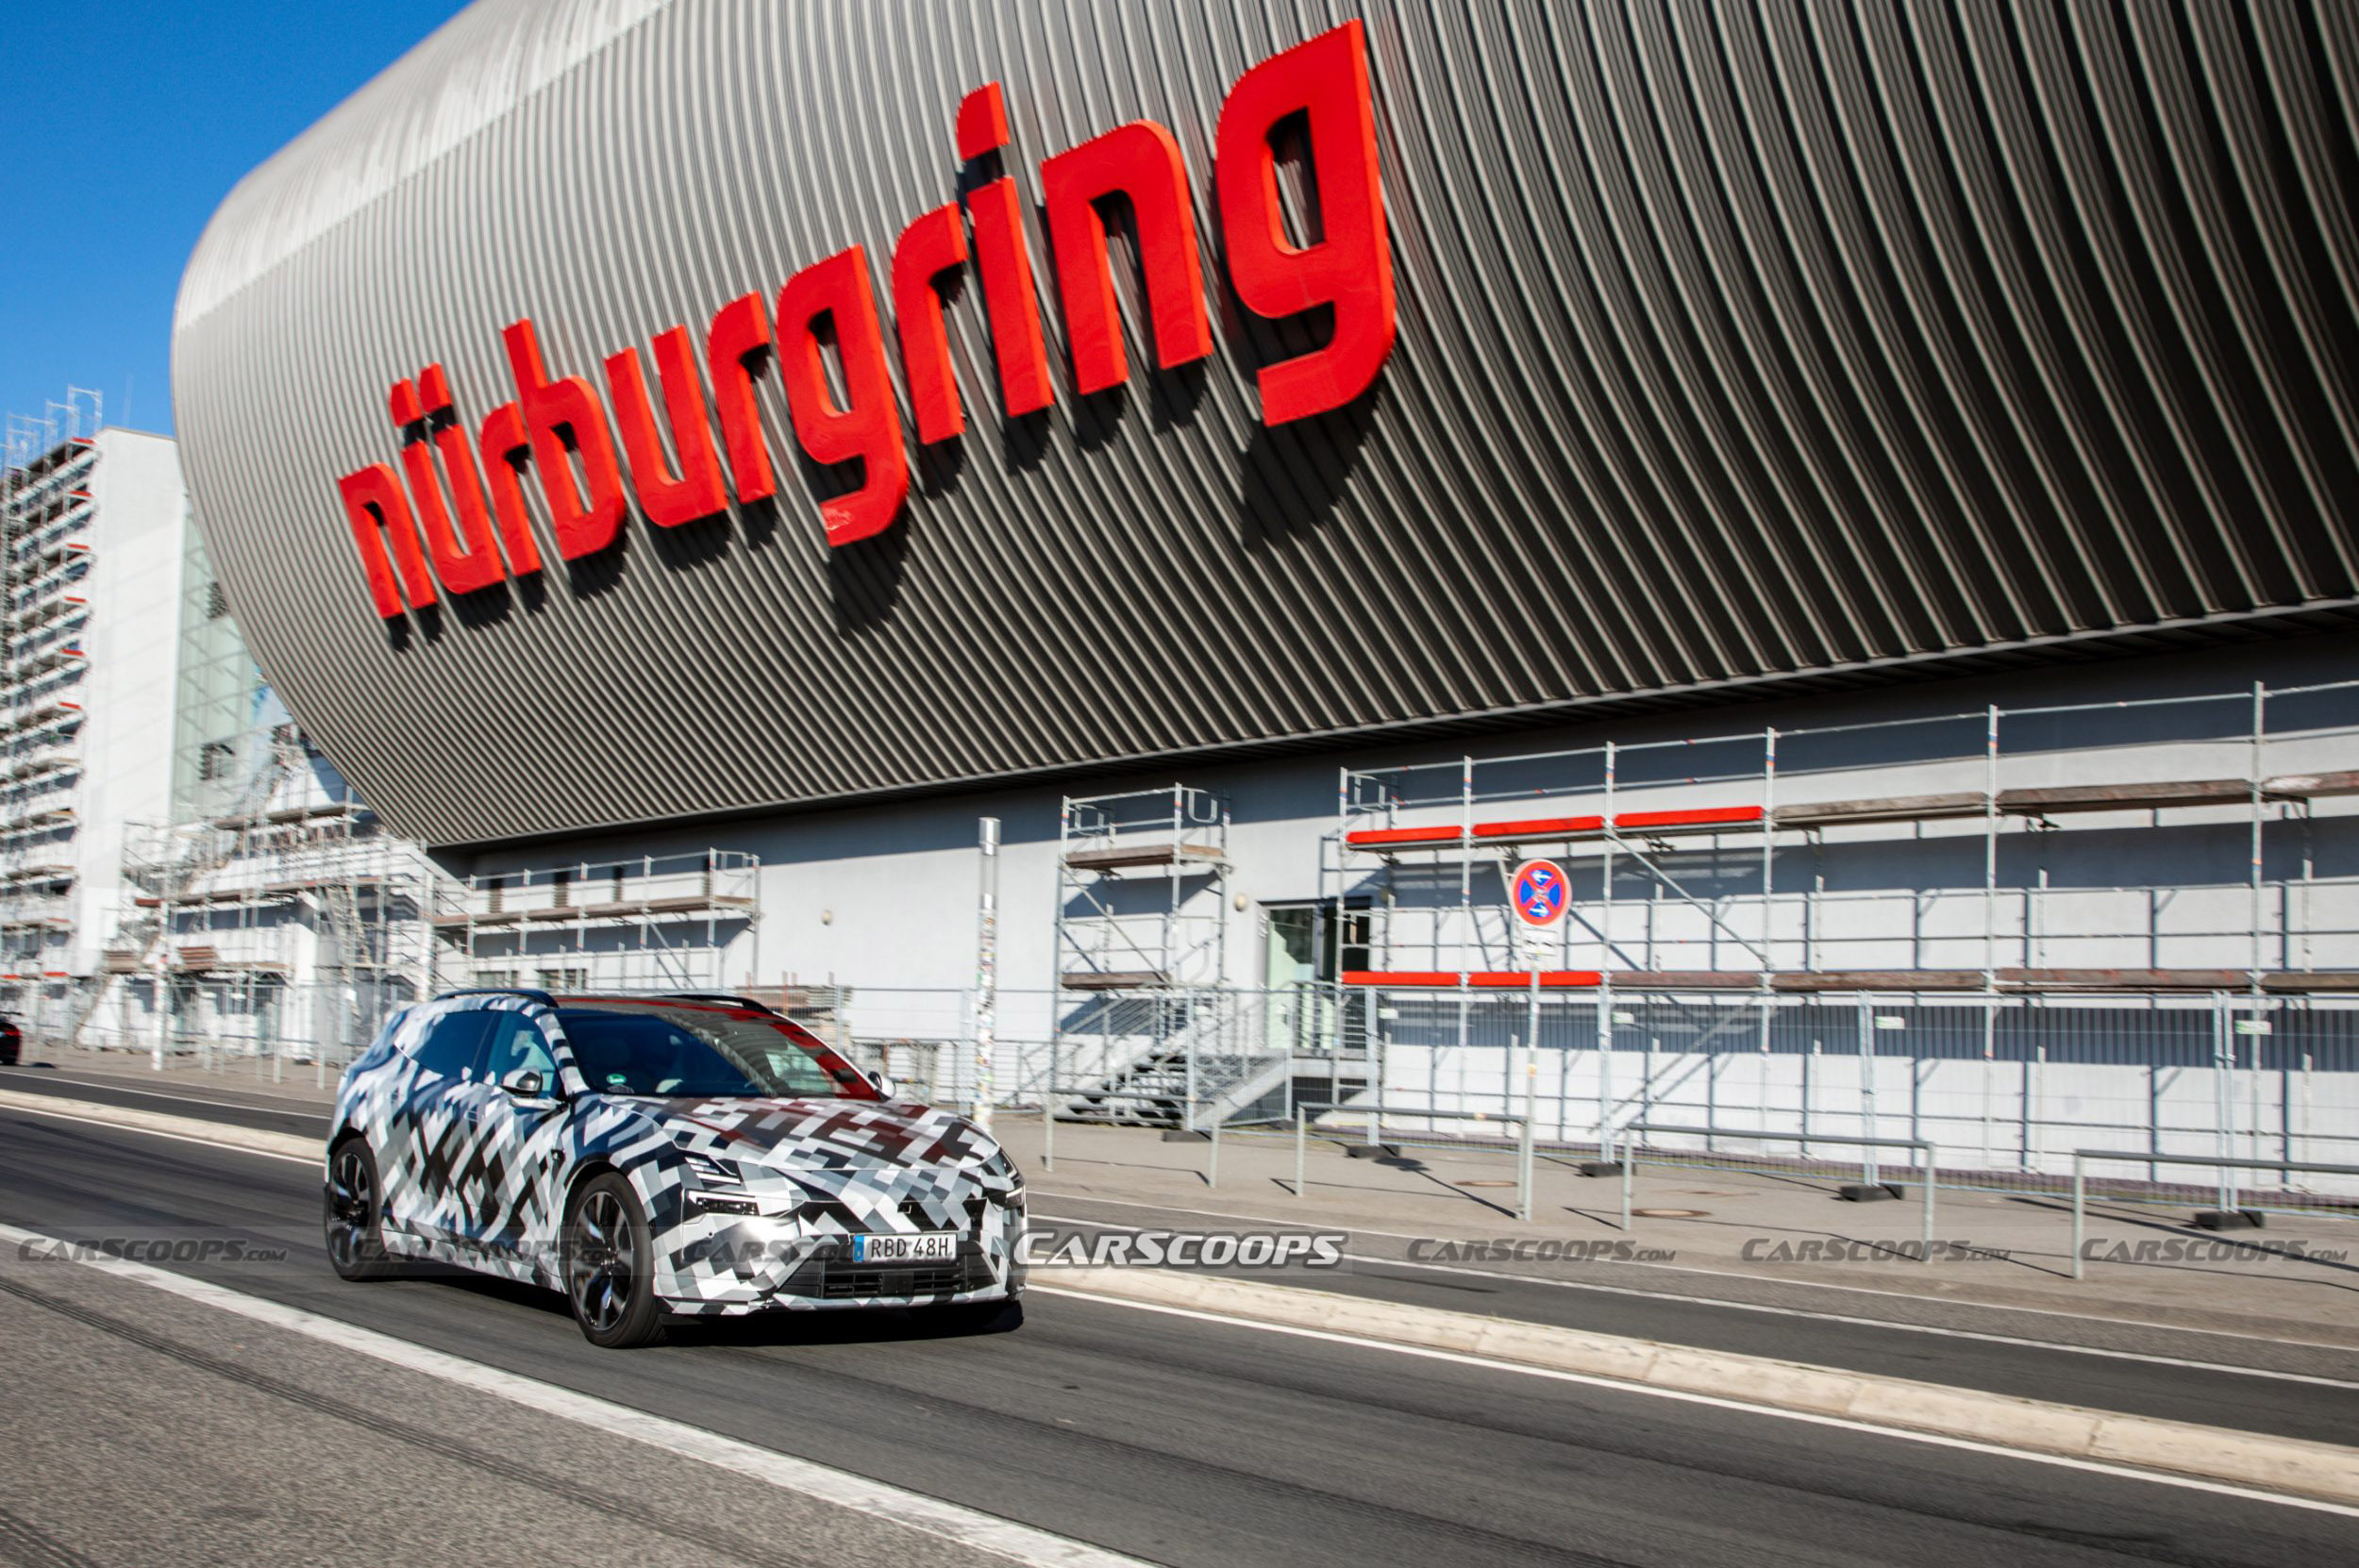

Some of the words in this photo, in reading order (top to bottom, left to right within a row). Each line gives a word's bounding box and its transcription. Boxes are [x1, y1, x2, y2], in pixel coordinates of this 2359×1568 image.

[338, 19, 1397, 618] nürburgring
[871, 1238, 907, 1258] RBD
[912, 1238, 949, 1257] 48H
